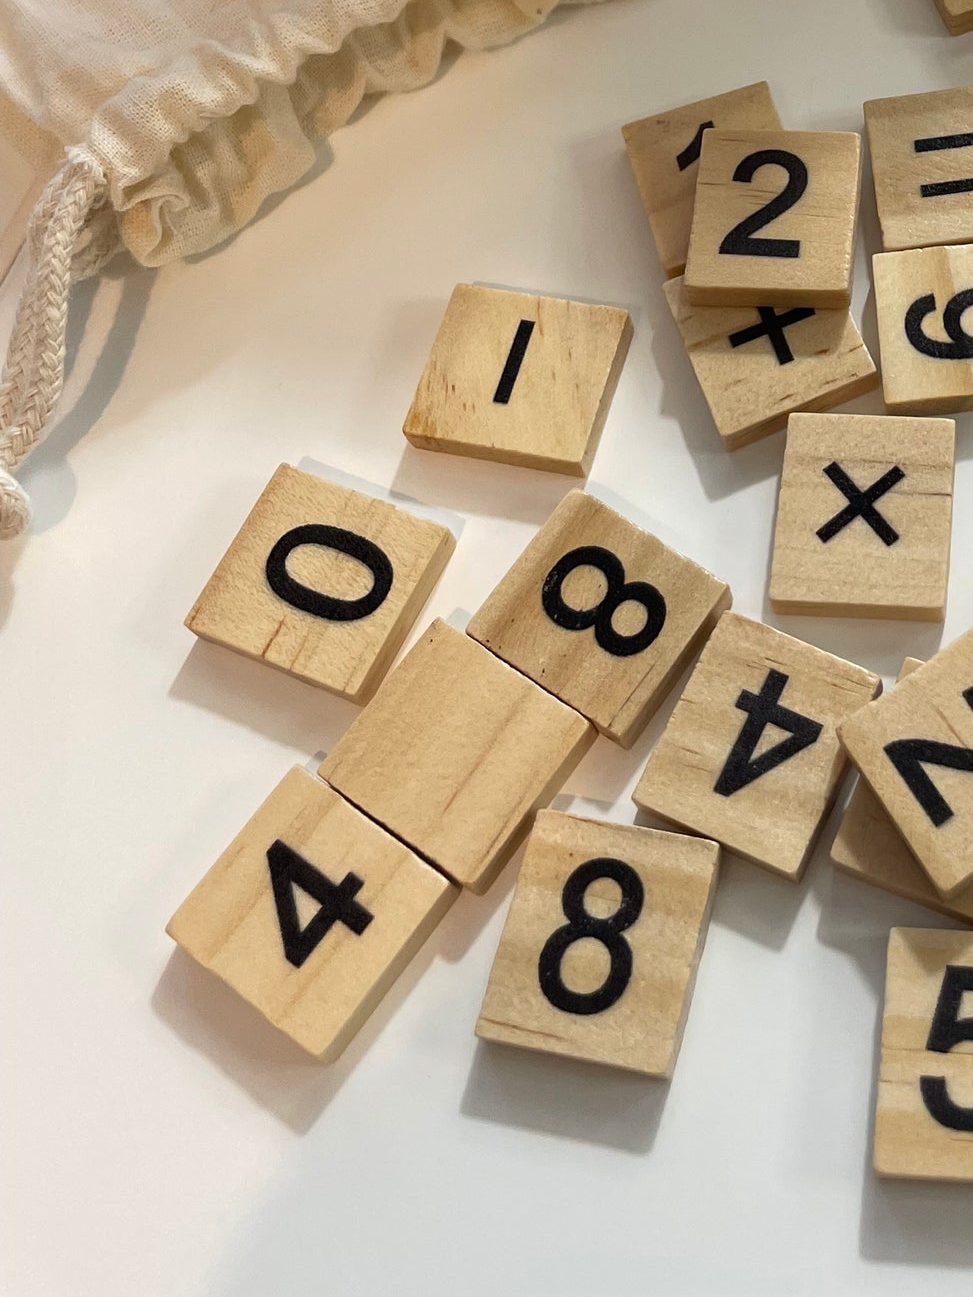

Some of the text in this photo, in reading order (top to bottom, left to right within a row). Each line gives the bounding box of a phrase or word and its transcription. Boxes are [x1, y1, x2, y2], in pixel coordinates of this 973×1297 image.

[718, 149, 809, 259] 2
[541, 545, 667, 658] 8
[713, 669, 824, 798] 4
[266, 838, 375, 969] 4
[538, 857, 646, 1016] 8
